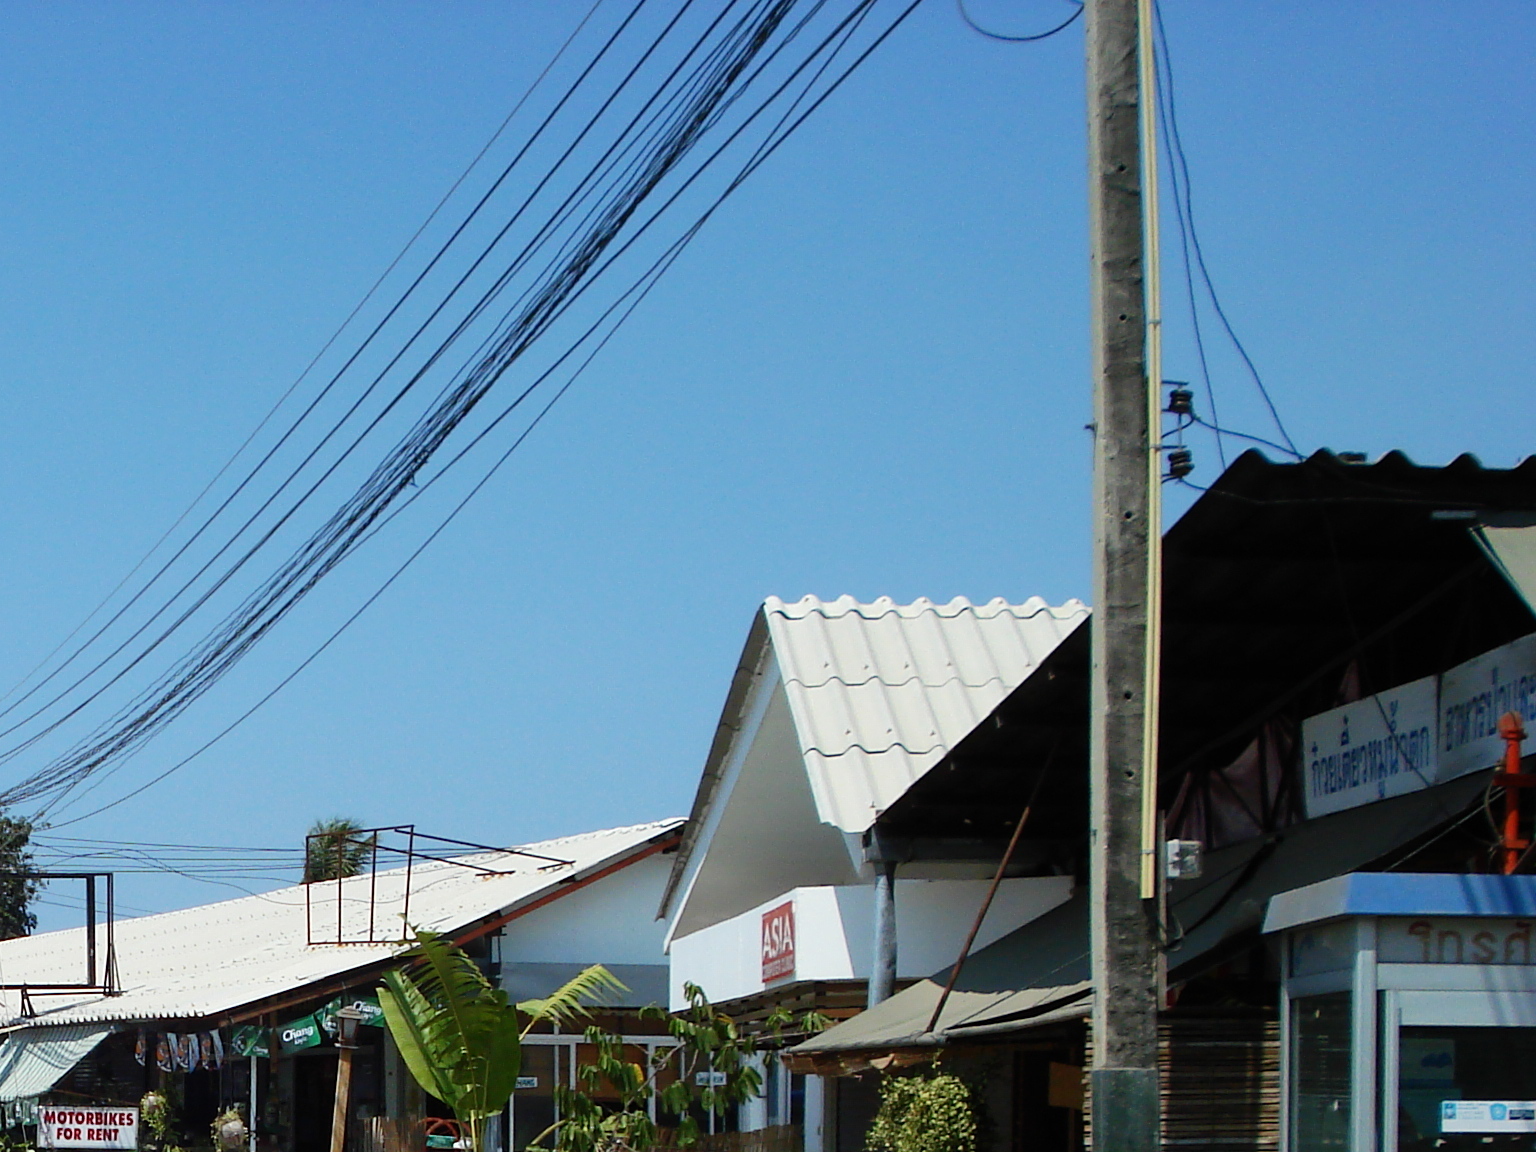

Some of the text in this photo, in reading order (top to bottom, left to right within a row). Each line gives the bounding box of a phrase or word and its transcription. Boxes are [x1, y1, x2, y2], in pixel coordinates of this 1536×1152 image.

[763, 913, 793, 958] ASIA
[353, 1000, 382, 1016] Chang
[283, 1025, 314, 1042] Chang
[44, 1111, 134, 1126] MOTORBIKES
[57, 1128, 119, 1141] FOR RENT
